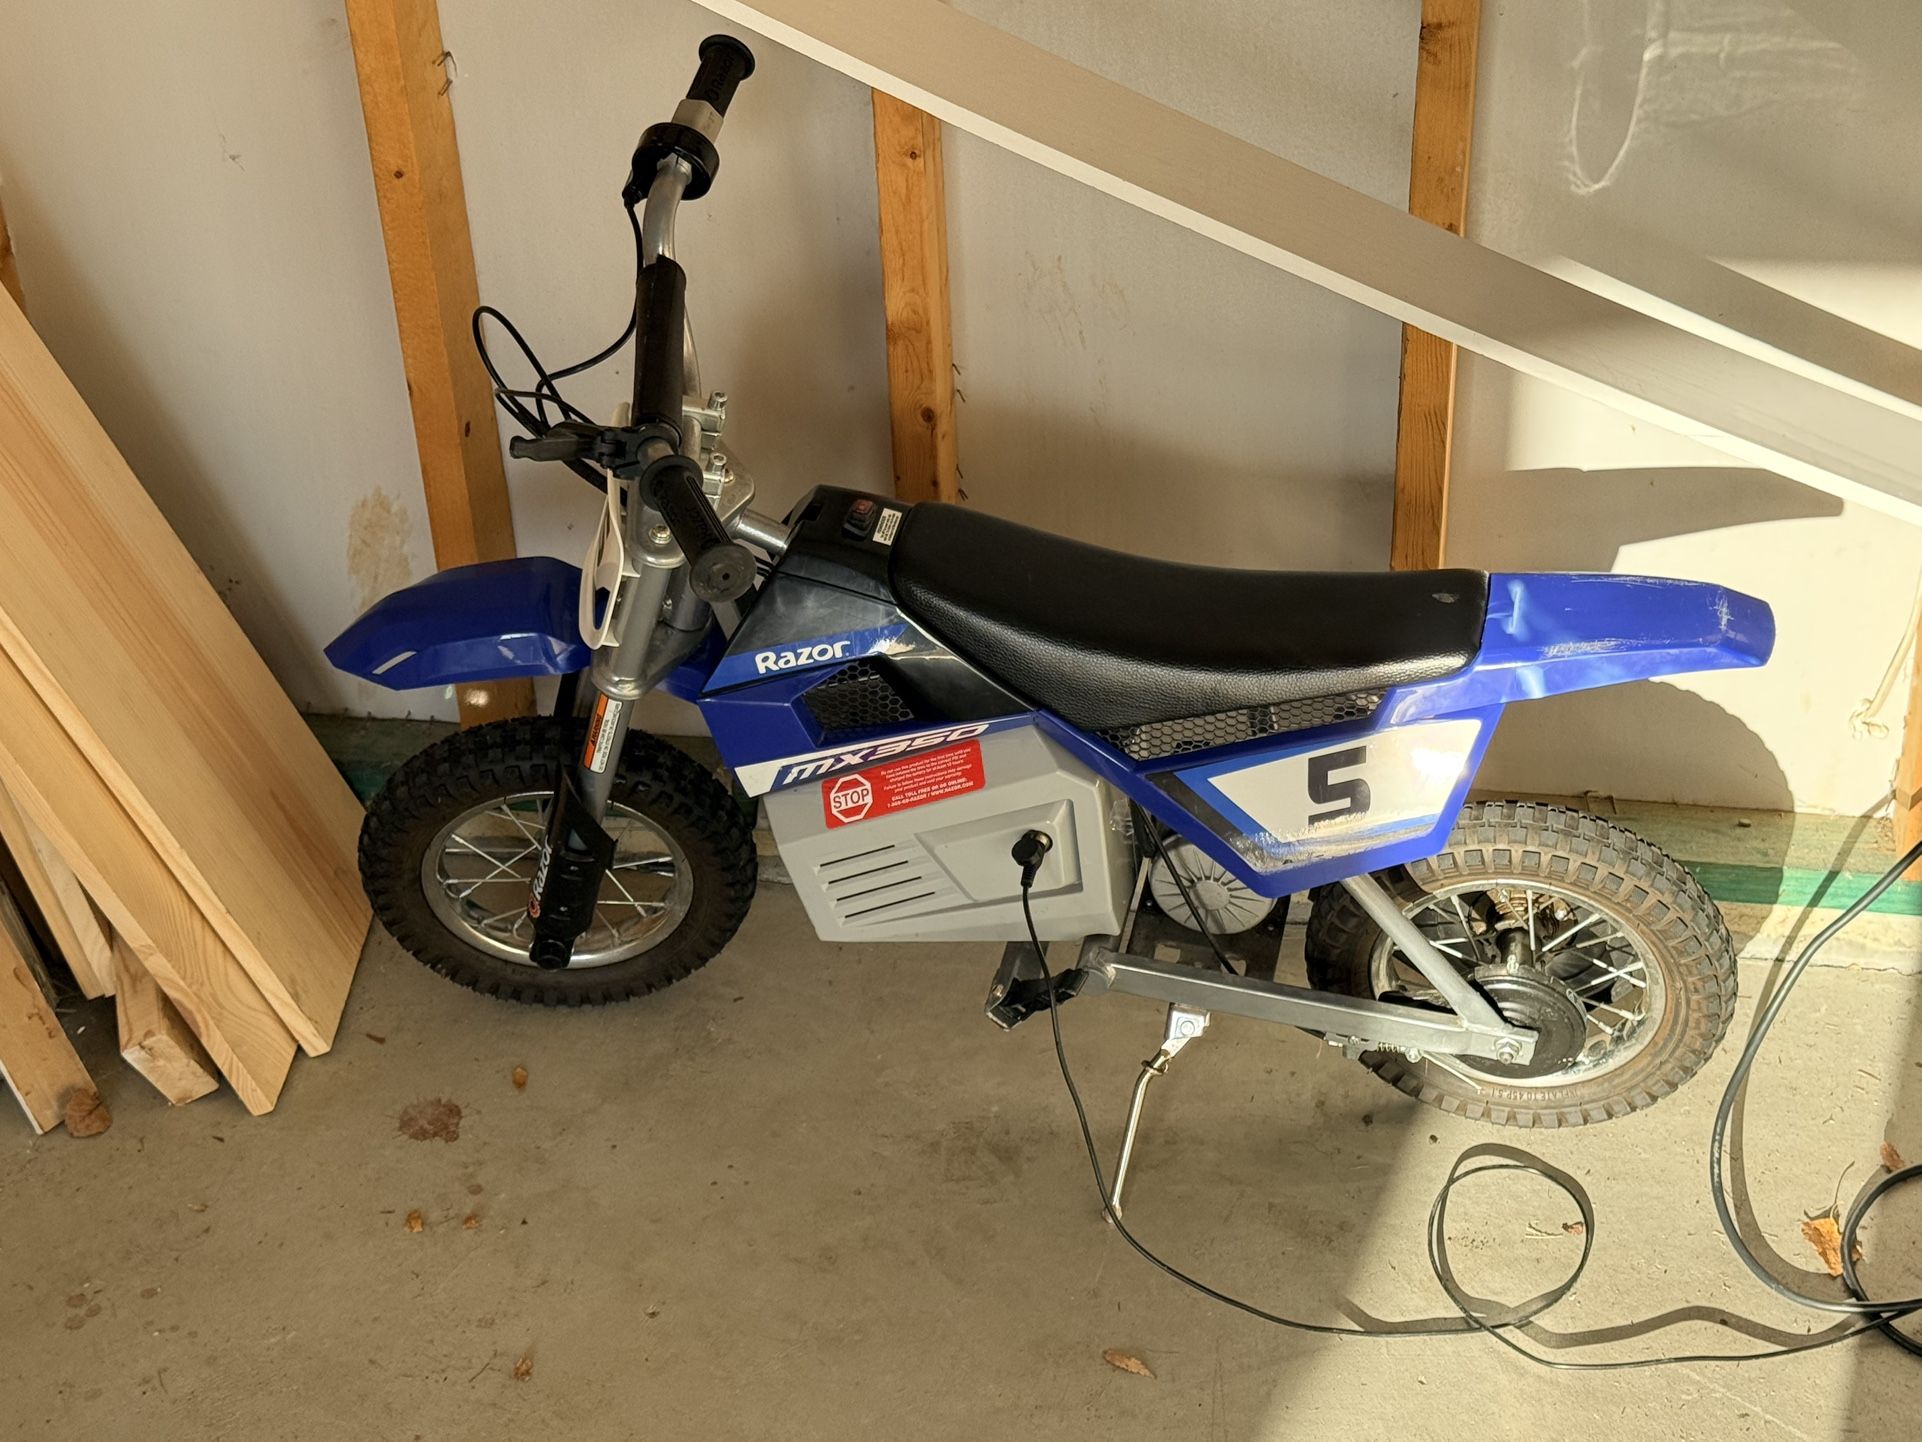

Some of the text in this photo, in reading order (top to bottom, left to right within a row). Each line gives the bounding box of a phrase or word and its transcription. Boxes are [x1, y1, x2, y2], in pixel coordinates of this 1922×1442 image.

[755, 641, 850, 674] Razor
[832, 787, 870, 809] STOP
[1308, 745, 1371, 826] 5
[533, 834, 553, 901] Razor
